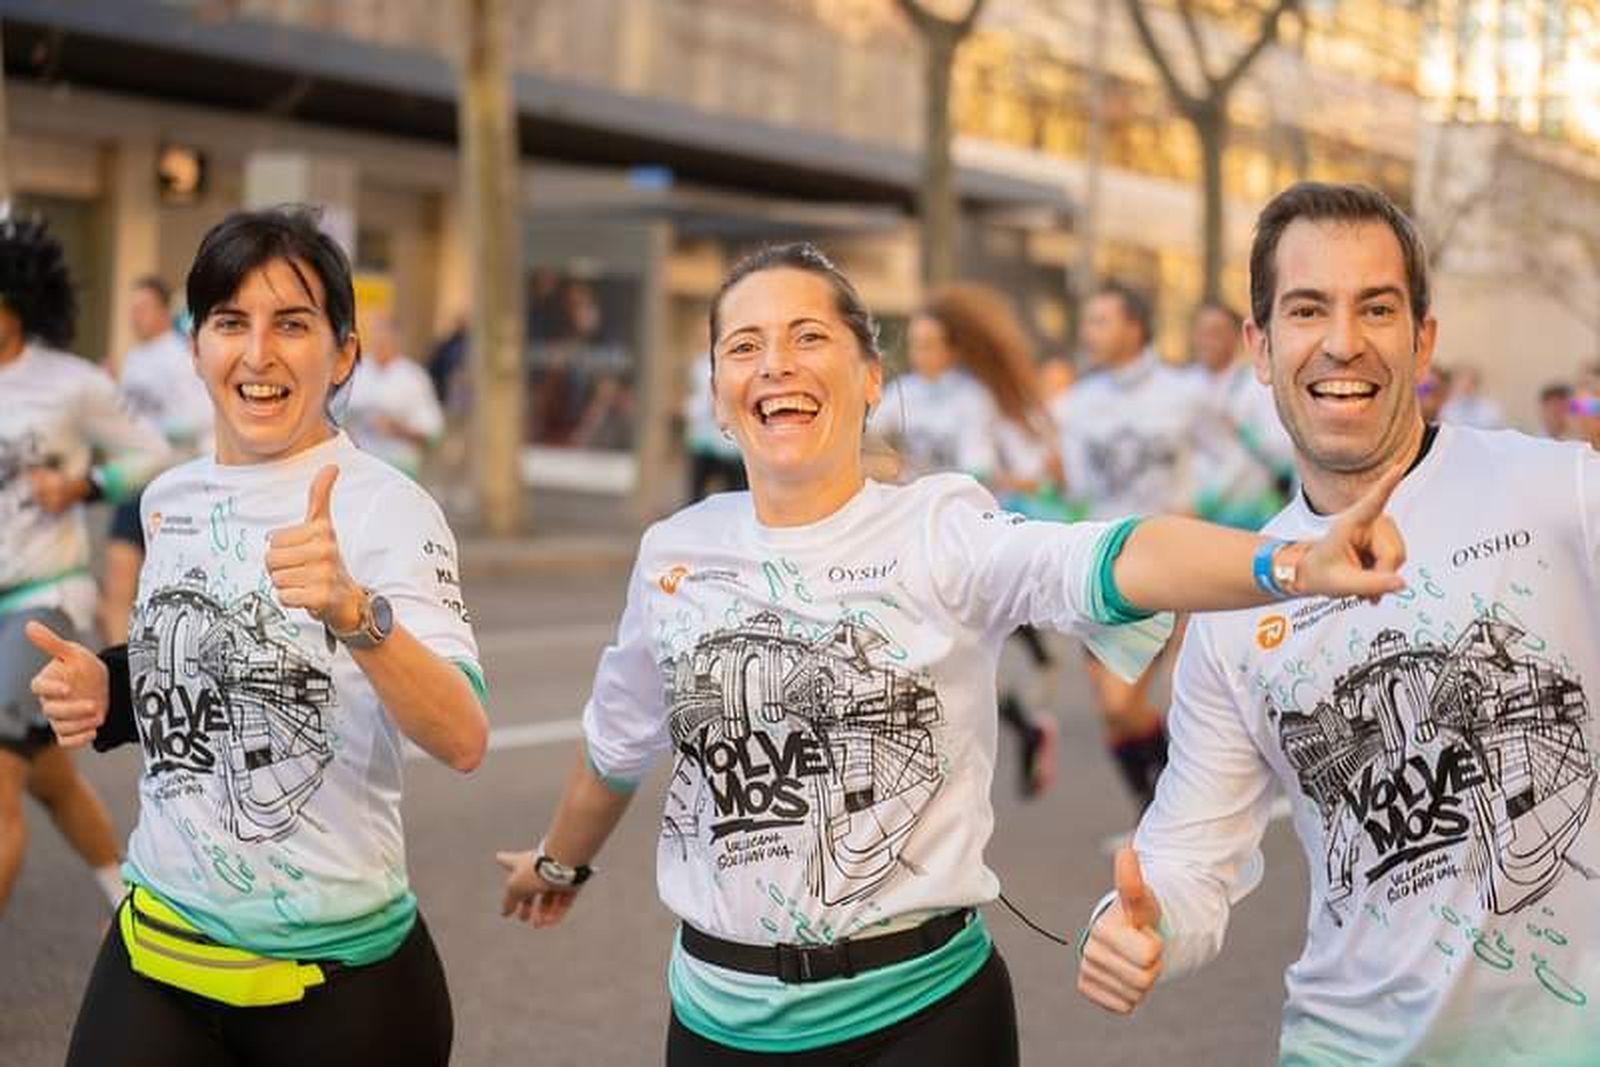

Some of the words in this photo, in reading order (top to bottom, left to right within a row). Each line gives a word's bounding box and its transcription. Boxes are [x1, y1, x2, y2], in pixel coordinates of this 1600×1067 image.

[1452, 529, 1531, 567] OYSHO
[141, 717, 215, 768] MOS
[680, 725, 829, 780] VOLVE
[708, 768, 810, 819] MOS
[1341, 745, 1486, 824] VOLVE
[1363, 796, 1470, 856] MOS
